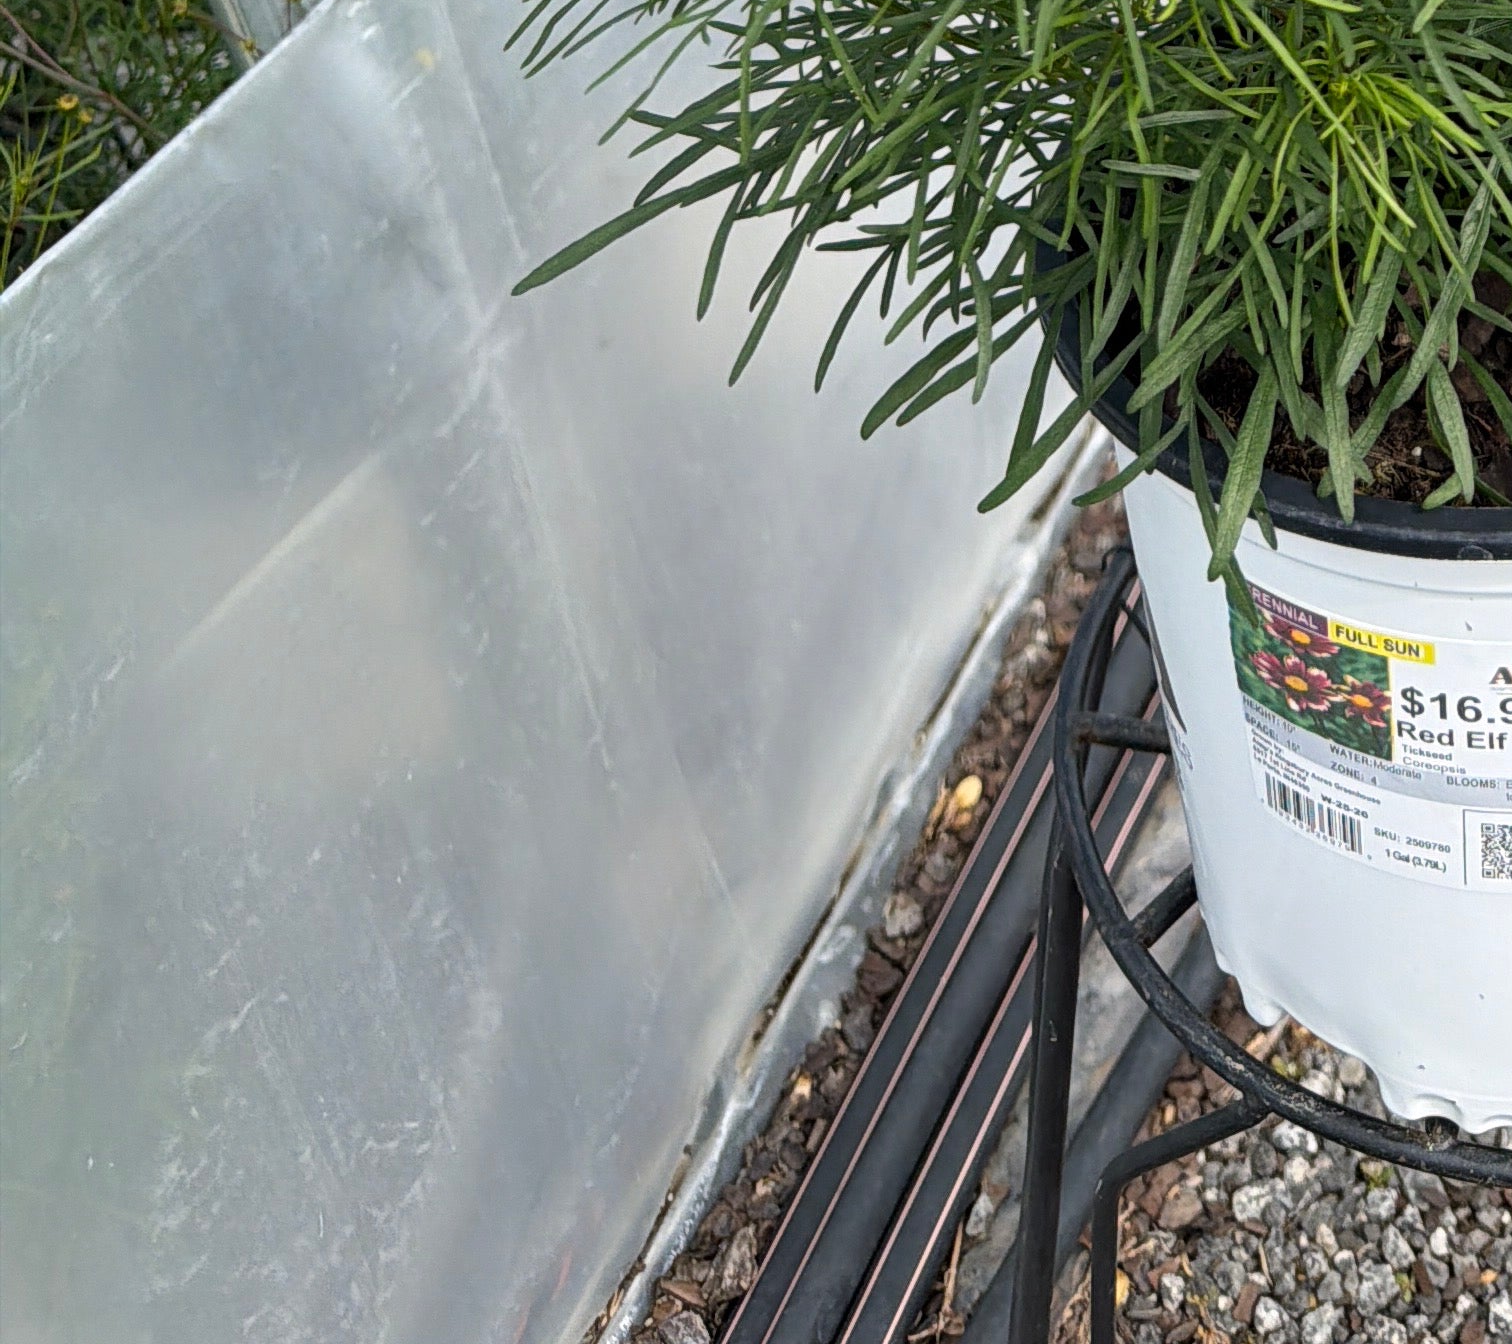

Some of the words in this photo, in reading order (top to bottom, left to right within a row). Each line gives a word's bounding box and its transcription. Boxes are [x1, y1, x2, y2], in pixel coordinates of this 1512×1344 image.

[1248, 584, 1319, 630] RENNIAL
[1335, 624, 1378, 649] FULL
[1383, 638, 1420, 657] SUN
[1396, 720, 1455, 747] Red
[1467, 731, 1508, 750] Elf
[1402, 743, 1452, 761] Tickseed
[1402, 756, 1466, 774] Coreopsis
